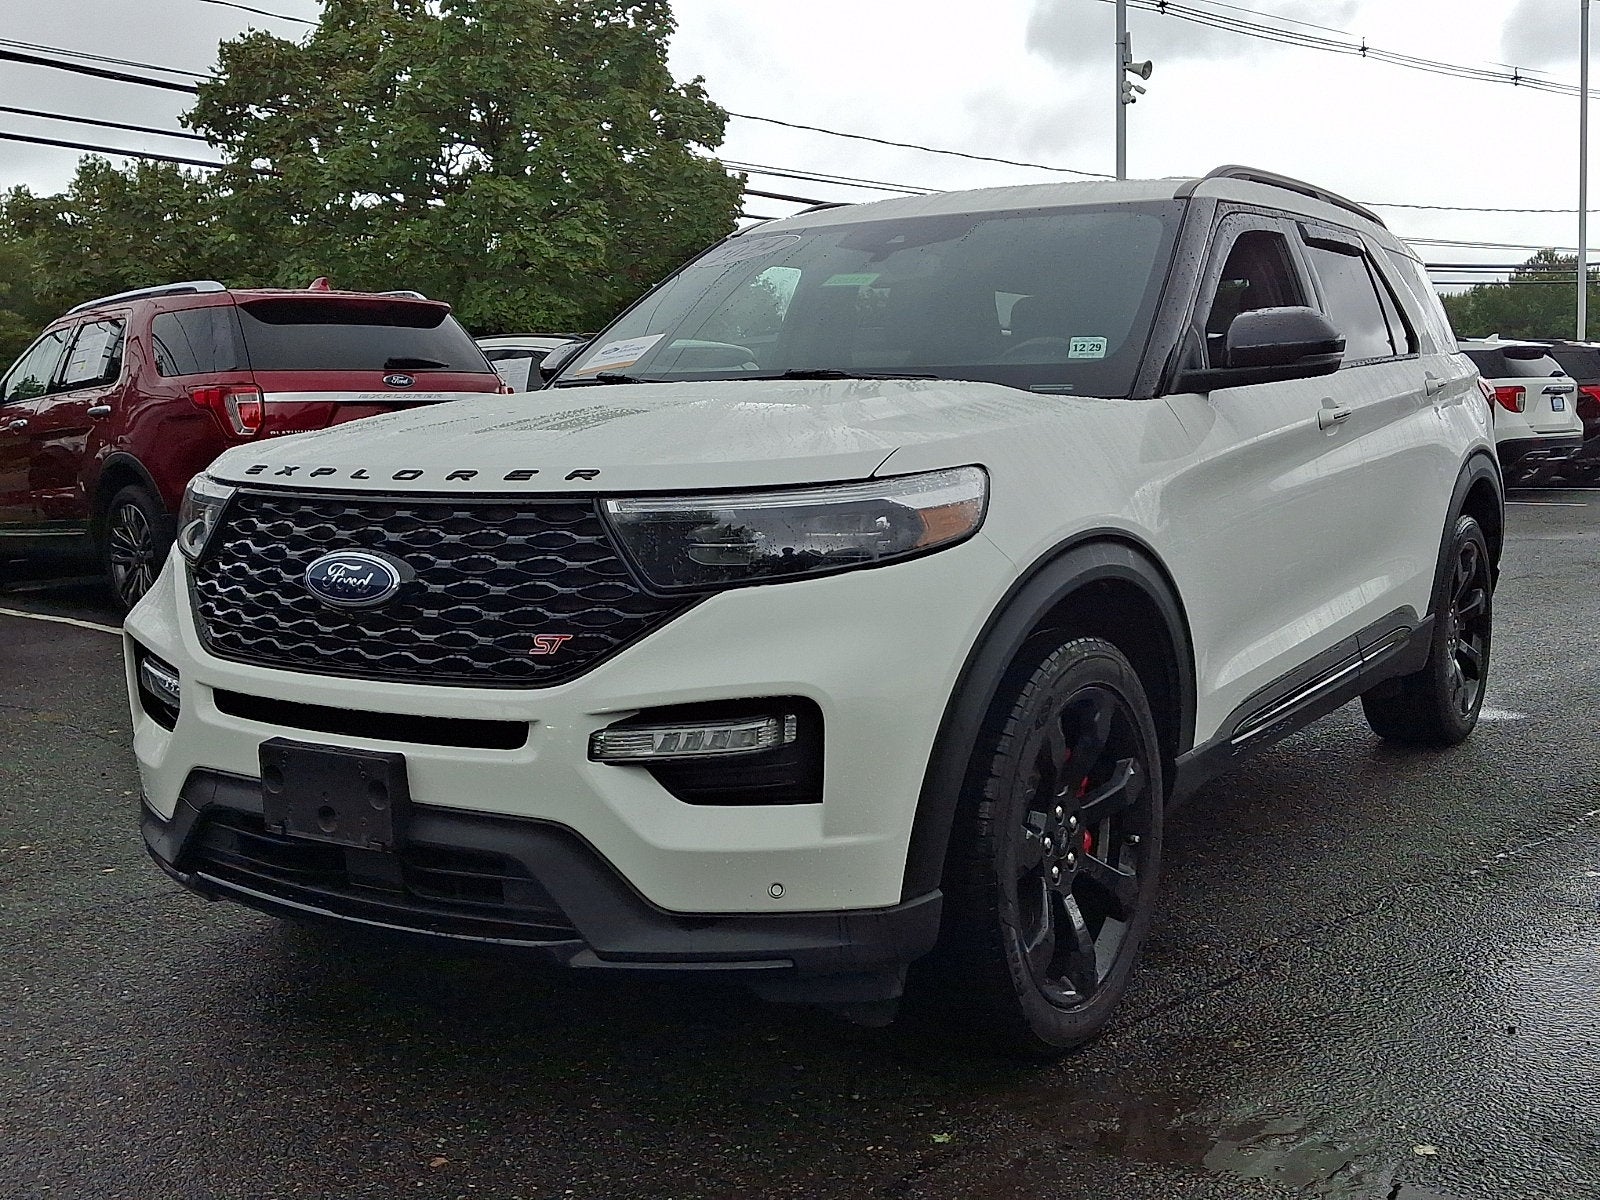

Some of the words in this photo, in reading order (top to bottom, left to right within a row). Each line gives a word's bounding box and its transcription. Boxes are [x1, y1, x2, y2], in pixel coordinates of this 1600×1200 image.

[1072, 343, 1086, 352] 12
[1088, 343, 1102, 352] 29
[391, 375, 409, 384] Ford
[244, 464, 601, 482] EXPLORER
[321, 562, 375, 592] Ford
[528, 633, 574, 655] ST
